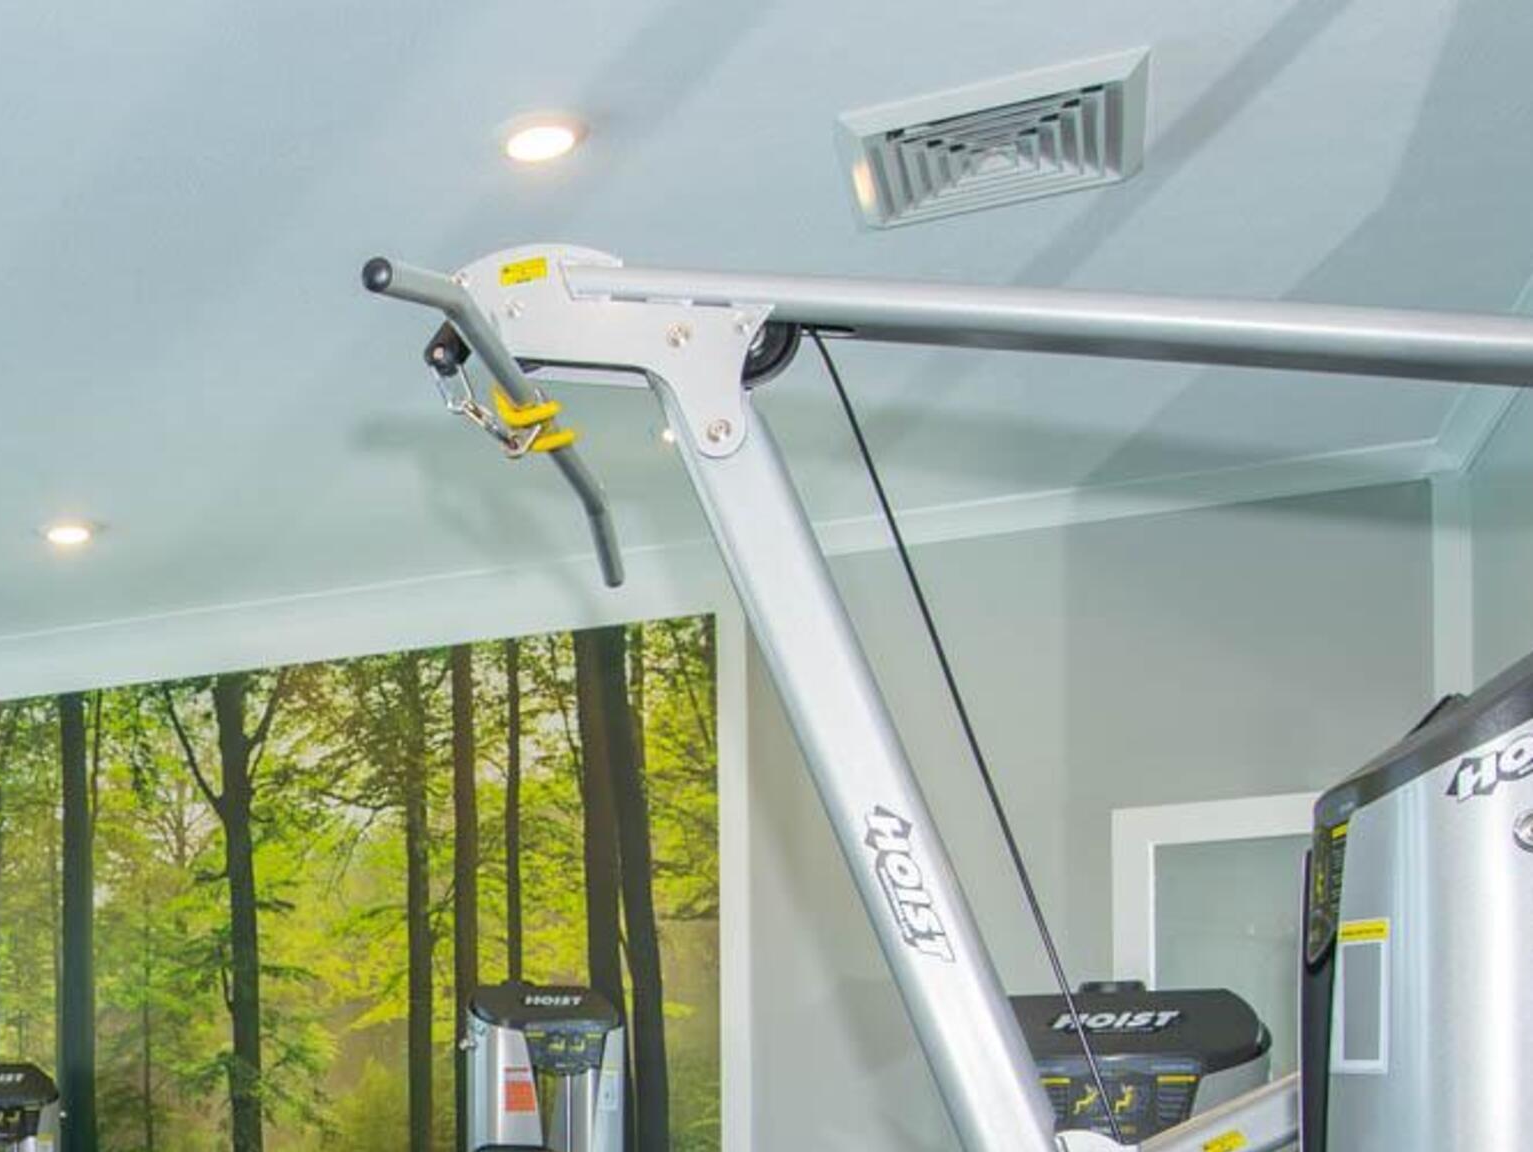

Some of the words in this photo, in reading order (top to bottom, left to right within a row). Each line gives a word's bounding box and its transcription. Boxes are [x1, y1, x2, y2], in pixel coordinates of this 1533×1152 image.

[864, 807, 956, 963] HOIST
[525, 994, 583, 1006] HOIST
[1052, 1010, 1181, 1031] HOIST
